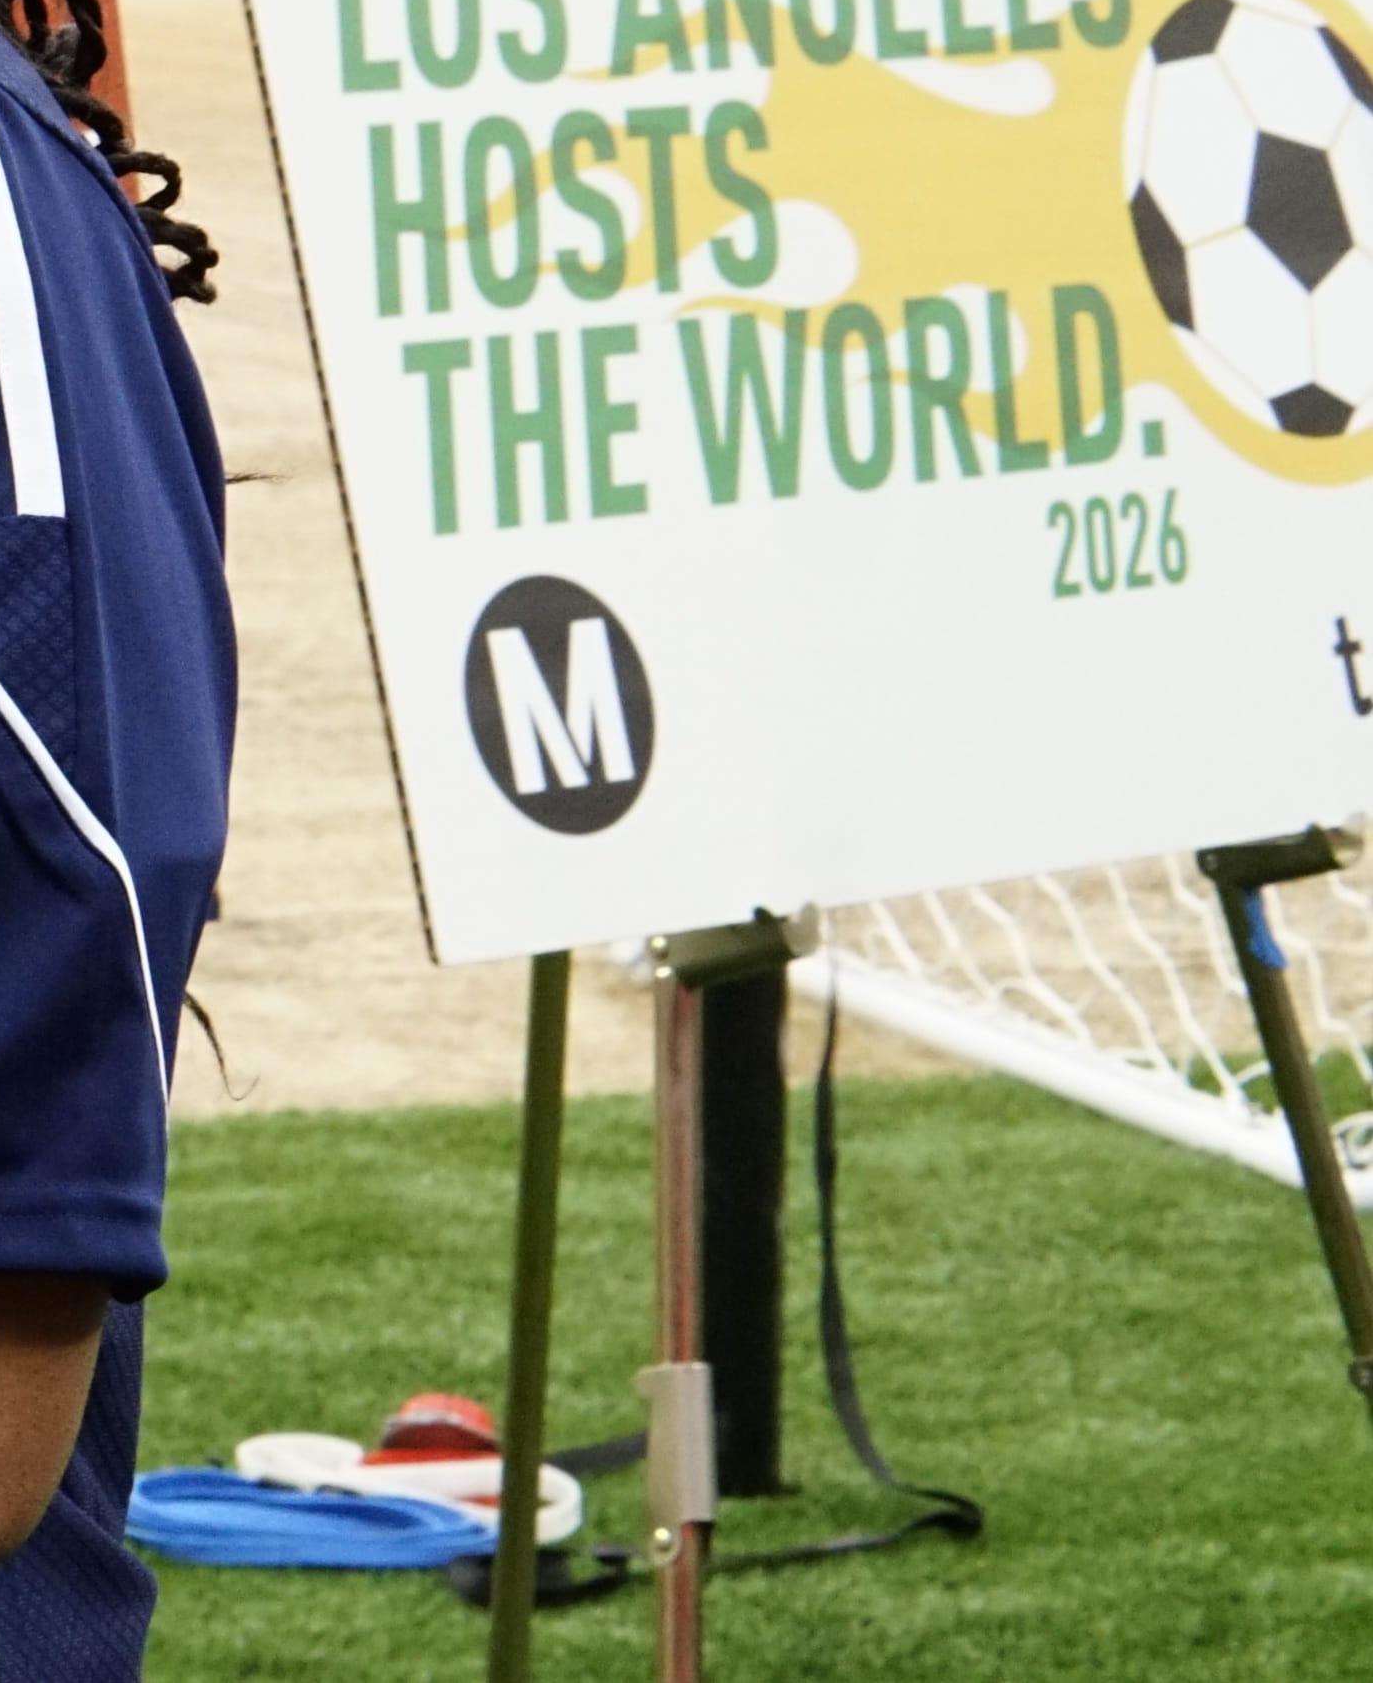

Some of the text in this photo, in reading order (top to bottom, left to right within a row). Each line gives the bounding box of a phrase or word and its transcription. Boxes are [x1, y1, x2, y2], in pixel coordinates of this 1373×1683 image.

[368, 100, 781, 317] HOSTS
[401, 283, 1167, 535] THE WORLD.
[1047, 488, 1189, 599] 2026
[485, 616, 637, 796] M
